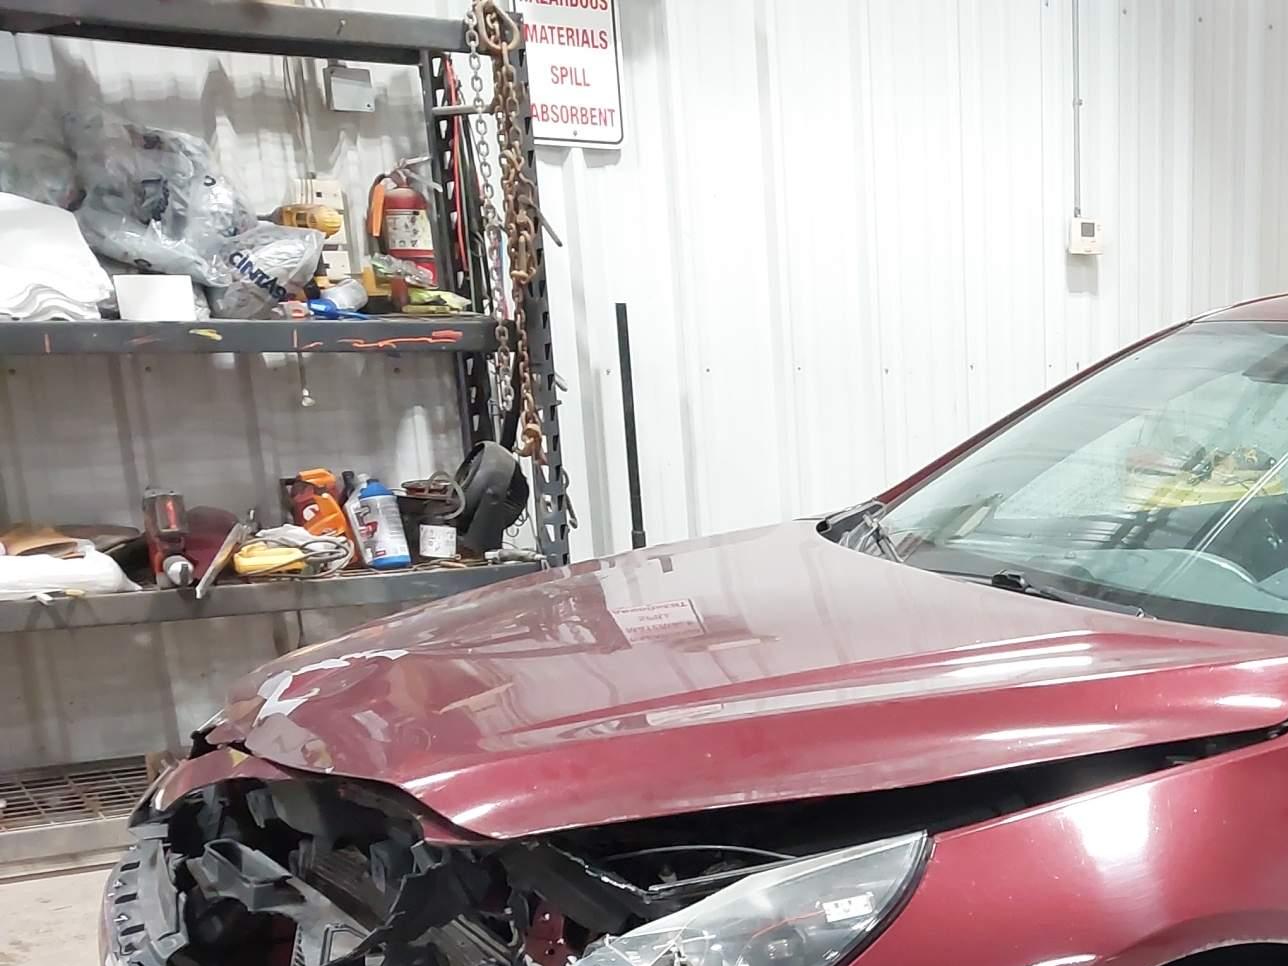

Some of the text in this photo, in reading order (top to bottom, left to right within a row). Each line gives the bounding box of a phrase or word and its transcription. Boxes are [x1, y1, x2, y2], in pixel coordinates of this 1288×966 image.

[523, 23, 608, 50] MATERIALS
[550, 64, 591, 87] SPILL
[530, 102, 615, 127] ABSORBENT
